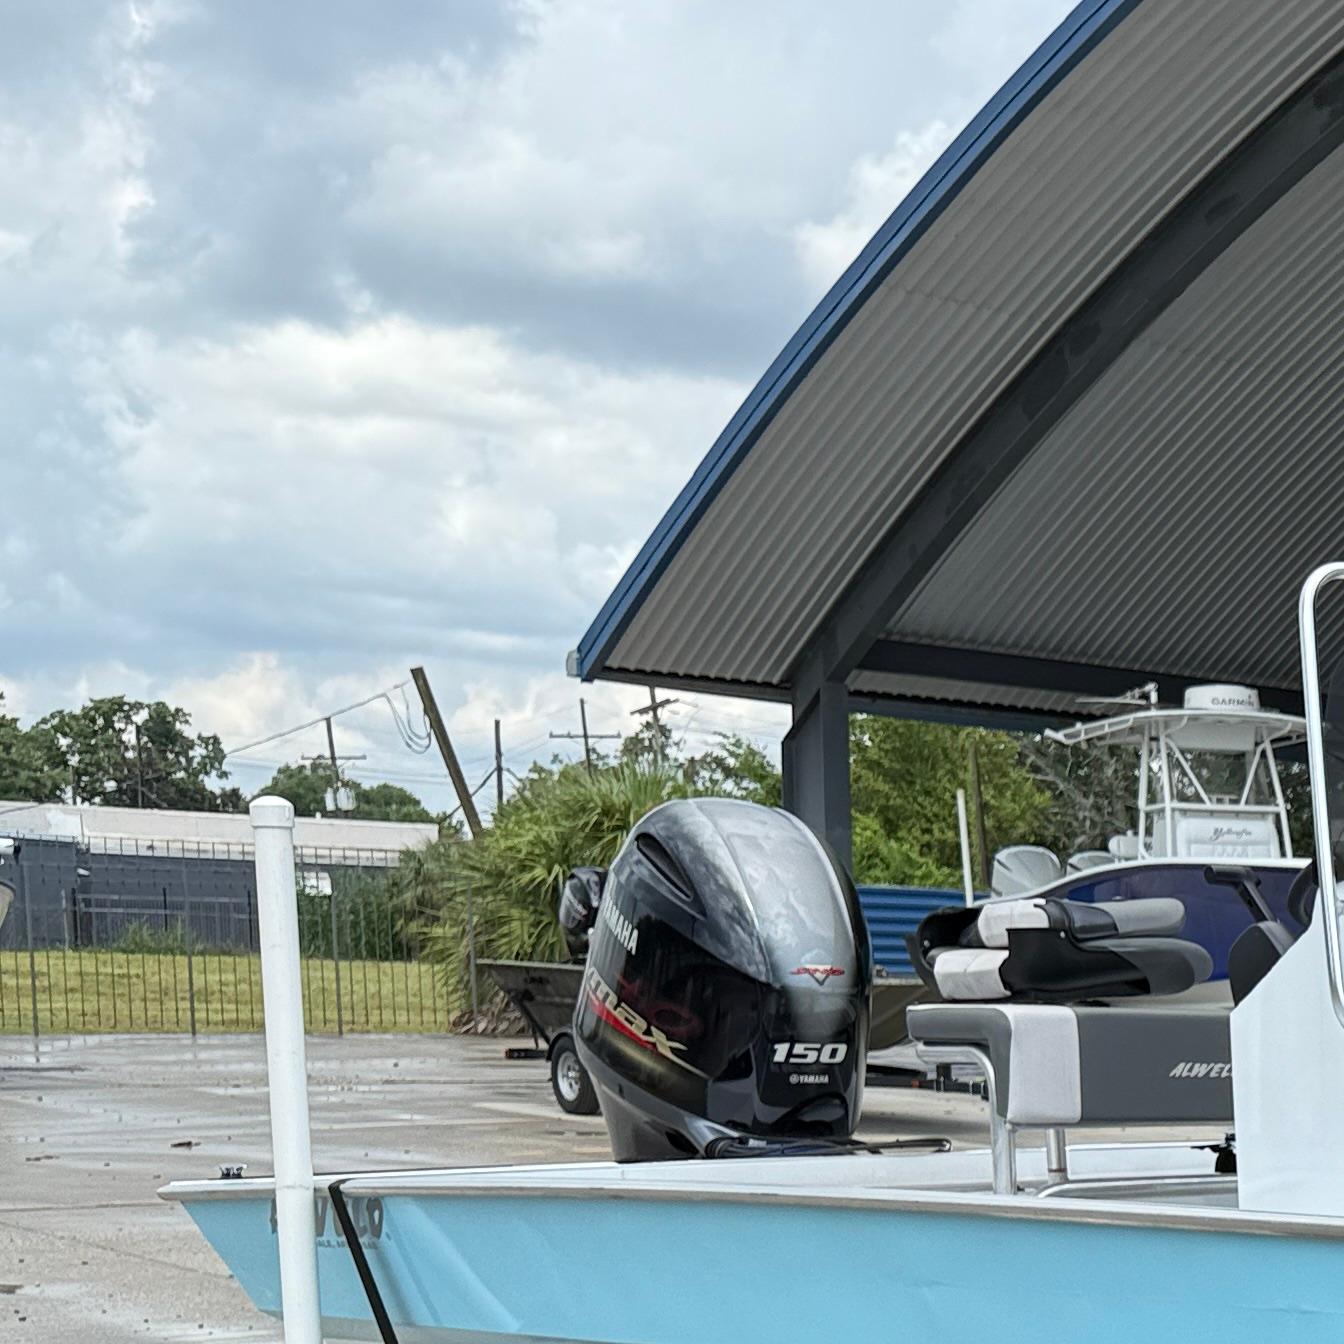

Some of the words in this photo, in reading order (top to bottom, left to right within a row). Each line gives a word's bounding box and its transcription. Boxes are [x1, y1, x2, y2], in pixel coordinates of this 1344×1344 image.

[603, 897, 639, 956] AMAHA
[773, 1042, 848, 1064] 150
[1168, 1062, 1234, 1078] ALWEL
